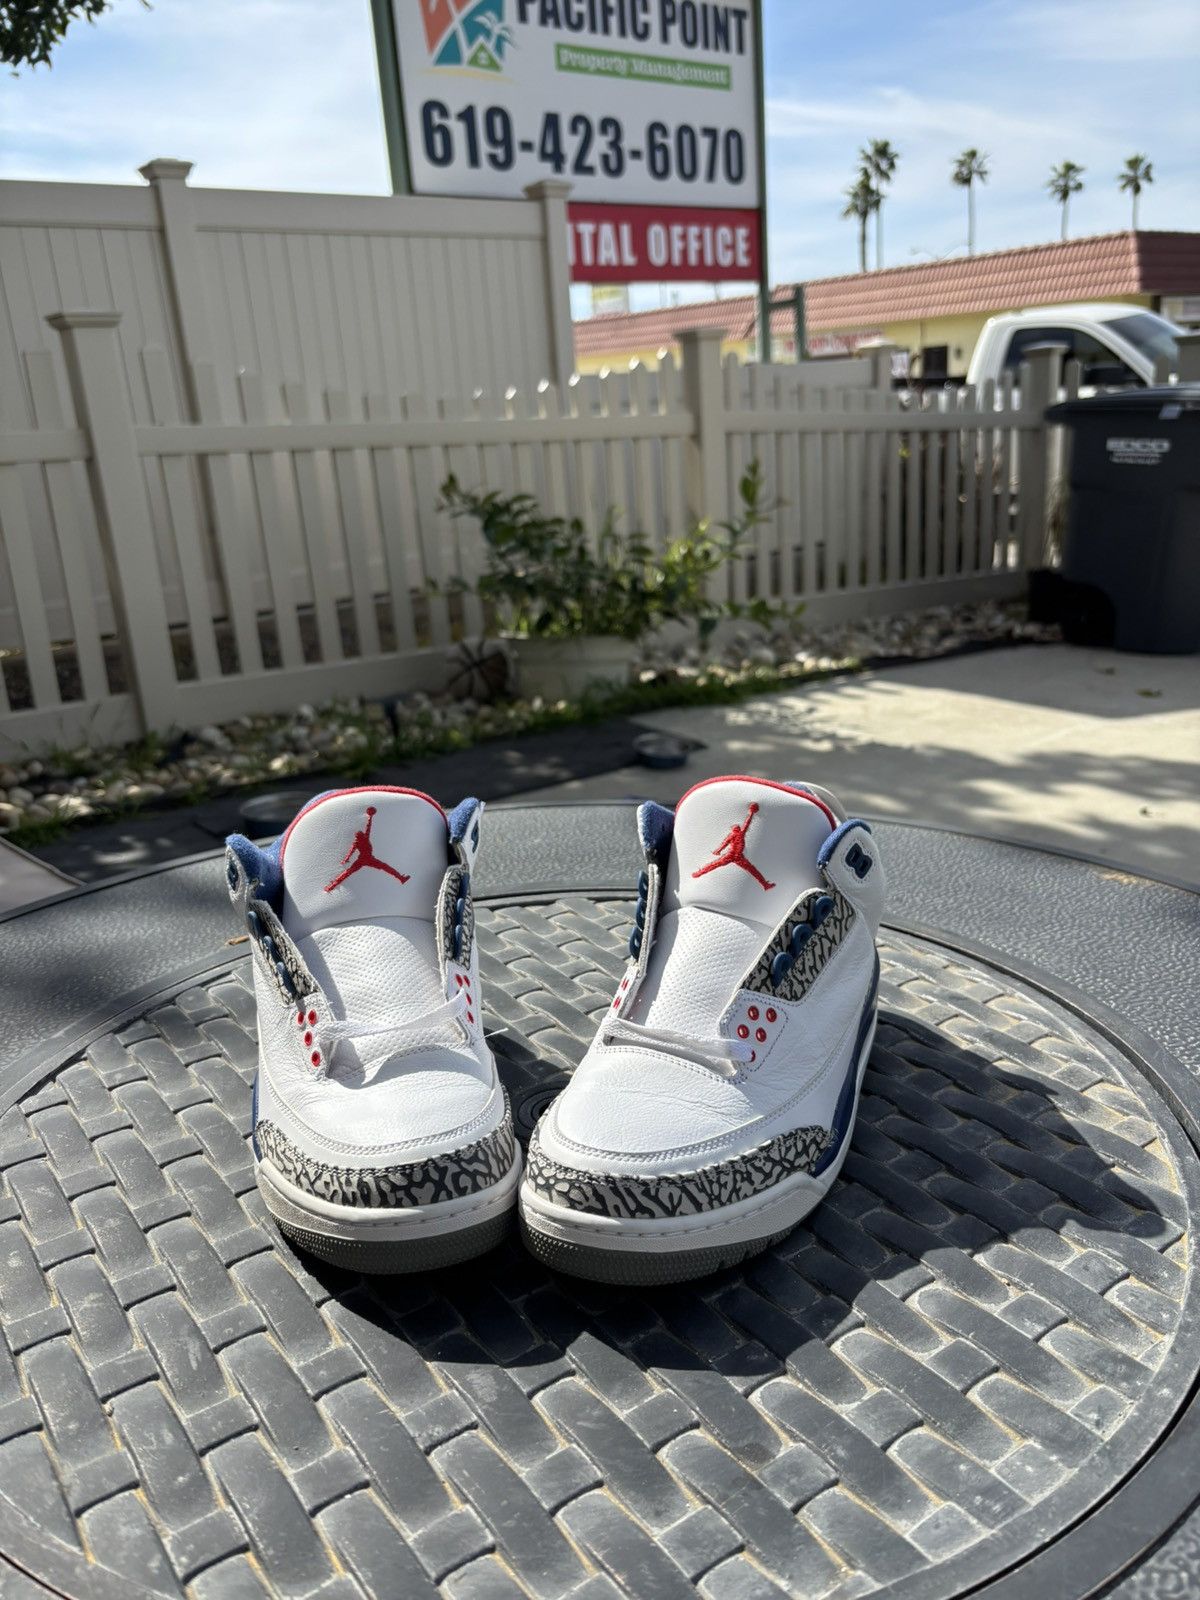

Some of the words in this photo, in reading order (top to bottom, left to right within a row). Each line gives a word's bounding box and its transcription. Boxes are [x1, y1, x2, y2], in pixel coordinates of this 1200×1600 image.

[660, 0, 747, 55] POINT
[560, 49, 627, 76] Property
[633, 58, 724, 85] Management
[422, 99, 744, 186] 619-423-6070
[647, 223, 751, 268] OFFICE
